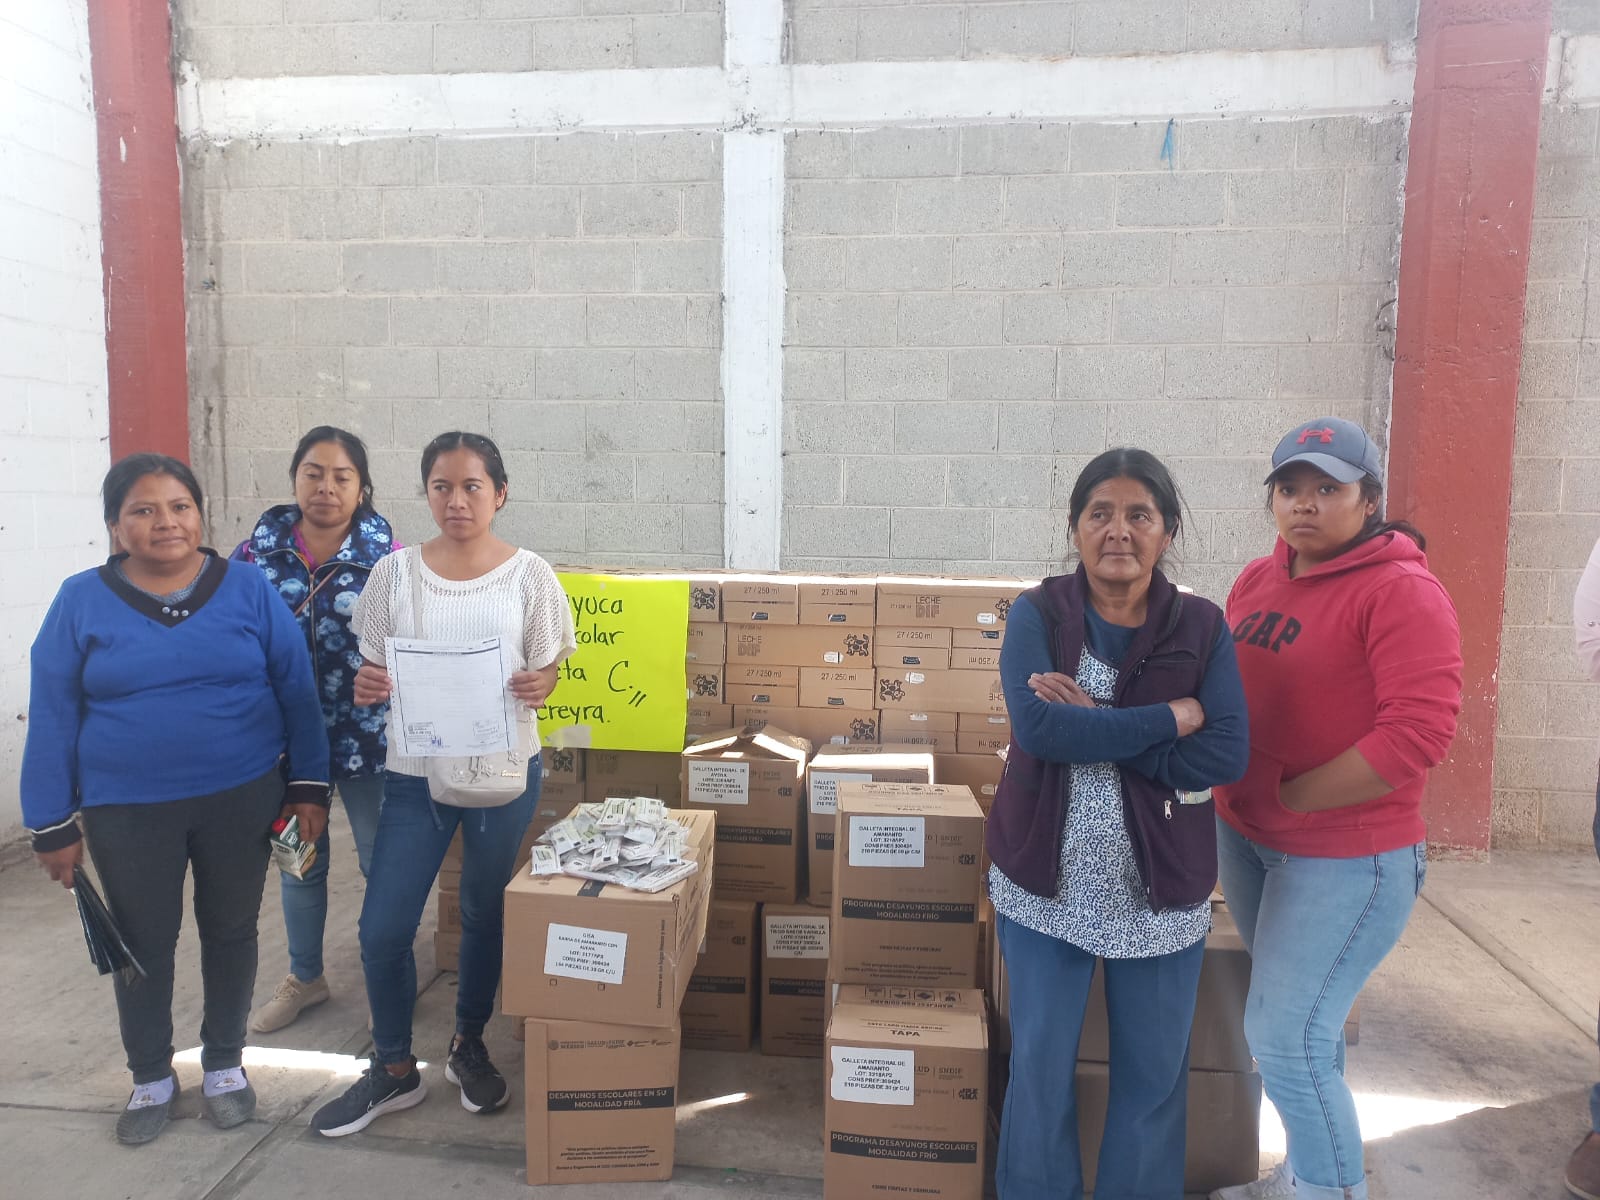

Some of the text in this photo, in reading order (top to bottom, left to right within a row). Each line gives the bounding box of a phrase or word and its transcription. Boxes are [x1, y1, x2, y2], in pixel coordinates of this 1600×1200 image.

[916, 596, 941, 604] LECHE
[567, 595, 623, 627] yuca
[916, 604, 940, 618] DIF
[1232, 610, 1302, 654] GAP
[737, 634, 762, 644] LECHE
[843, 900, 974, 912] PROGRAMA DESAYUNOS ESCOLARES
[876, 911, 920, 920] MODALIDAD
[598, 1090, 642, 1098] ESCOLARES
[574, 1099, 642, 1108] MODALIDAD FRÍA
[832, 1133, 976, 1150] PROGRAMA DESAYUNOS ESCOLARES
[868, 1148, 938, 1160] MODALIDAD FRÍO
